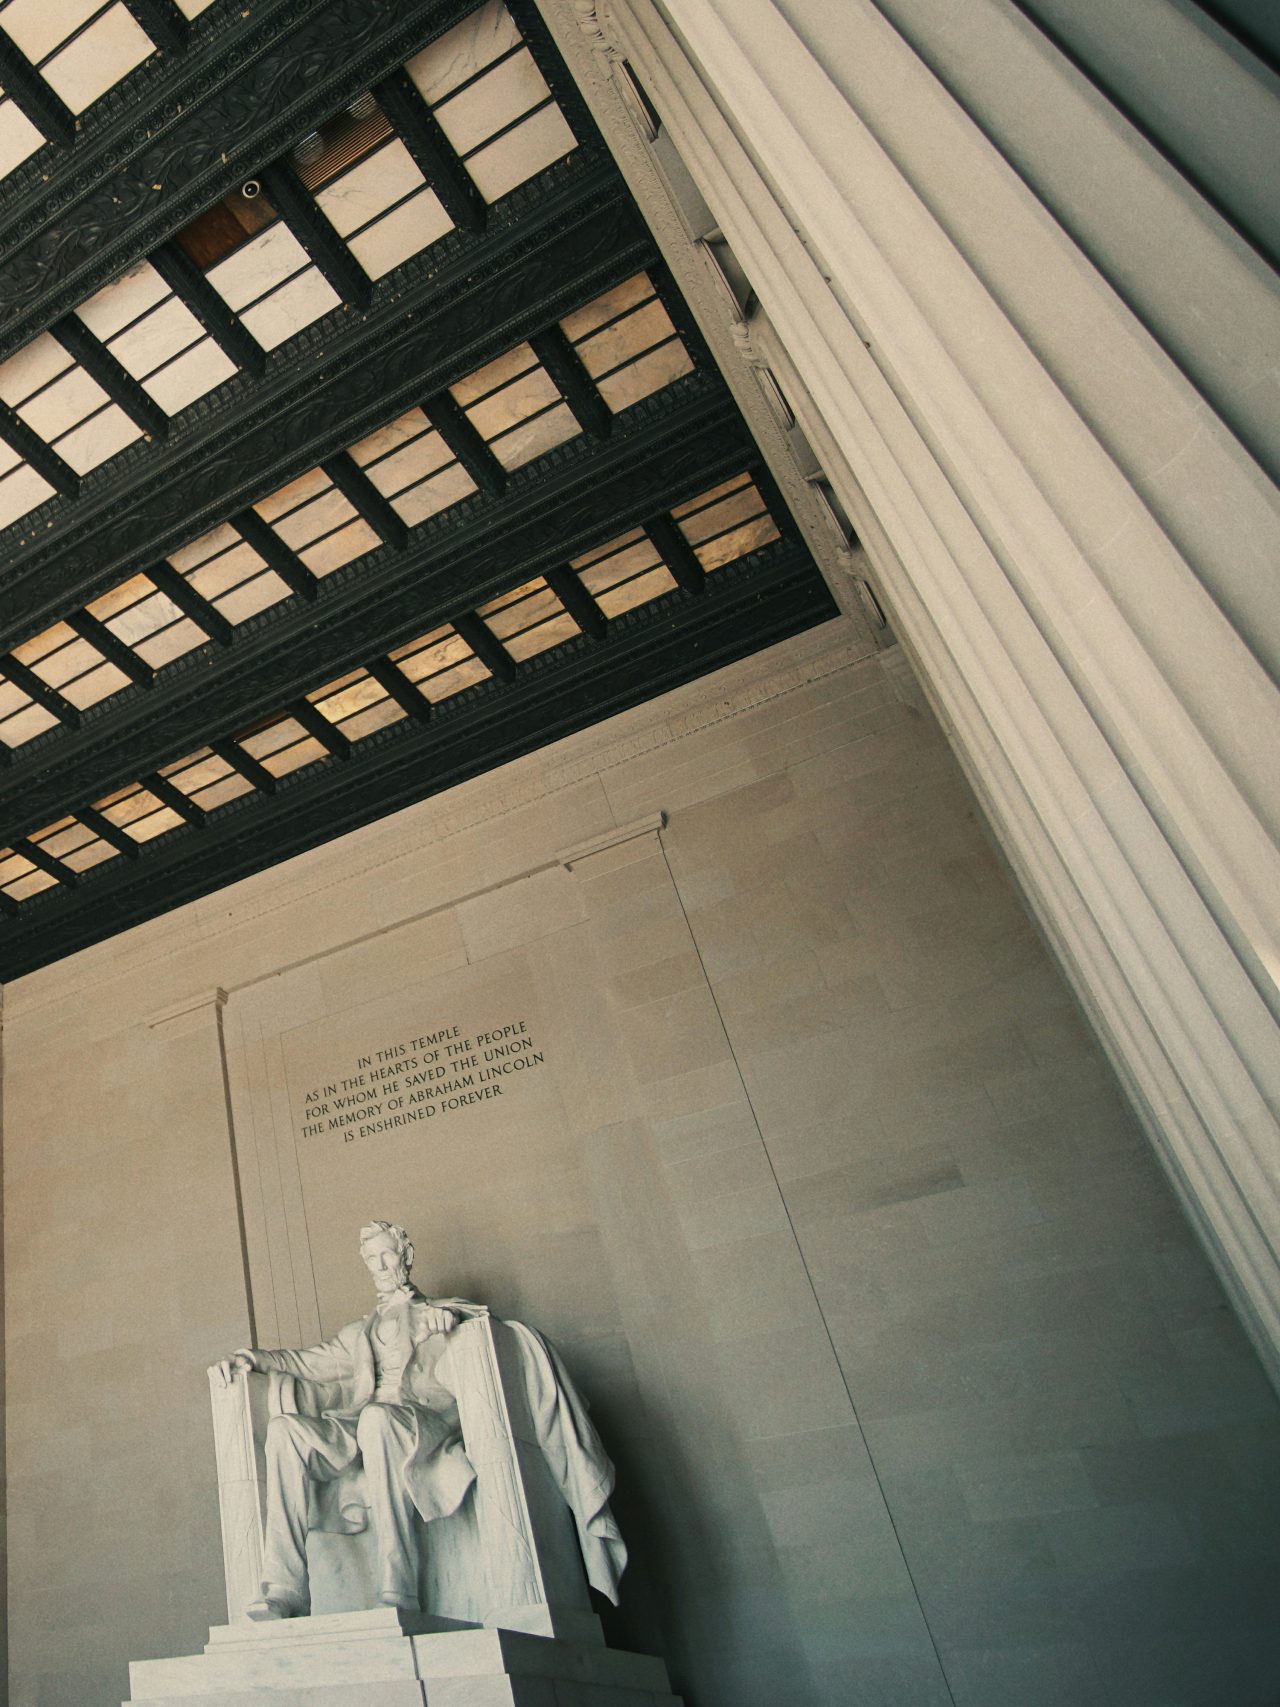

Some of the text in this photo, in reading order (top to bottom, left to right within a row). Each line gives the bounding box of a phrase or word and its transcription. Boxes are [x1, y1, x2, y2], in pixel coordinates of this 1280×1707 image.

[305, 1020, 527, 1104] AS IN THE HEARTS OF THE PEOPLE
[305, 1037, 533, 1120] FOR WHOM HE SAVED THE UNION
[357, 1025, 461, 1069] IN THIS TEMPLE
[301, 1051, 544, 1138] THE MEMORY OF ABRAHAM LINCOLN
[343, 1084, 504, 1143] IS ENSHRINED FOREVER
